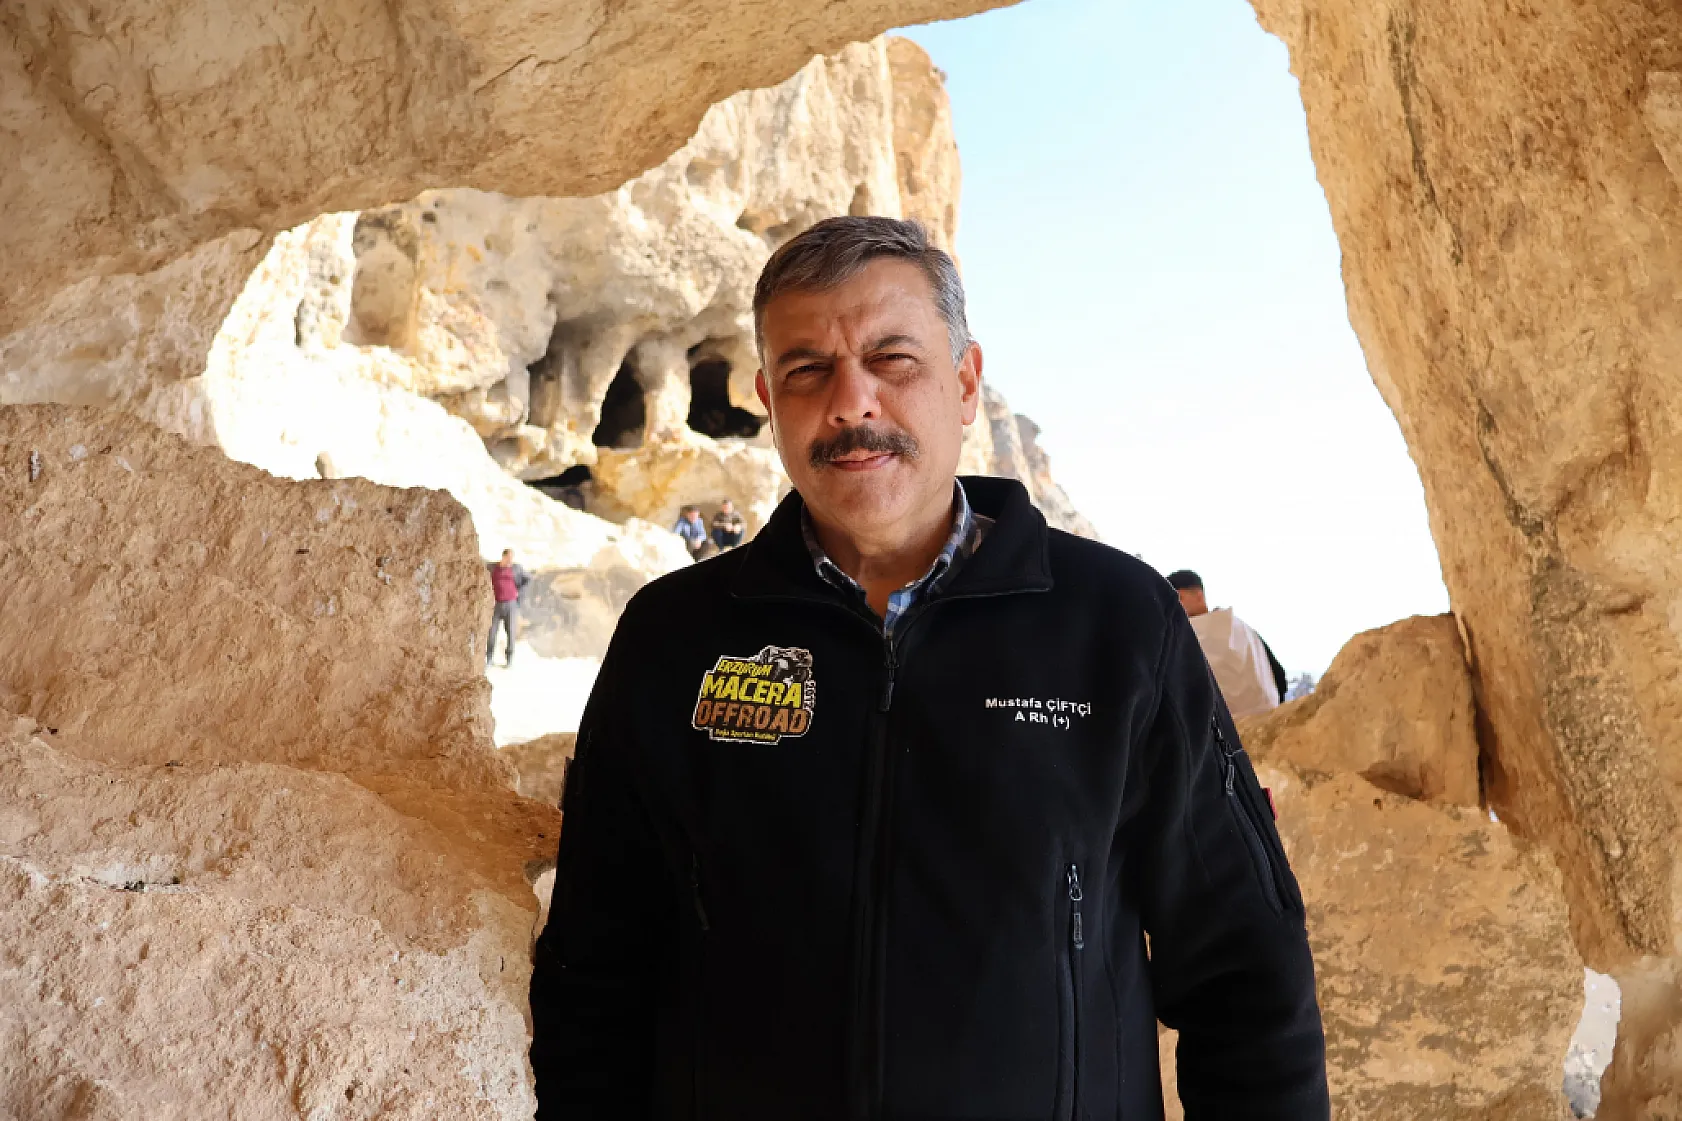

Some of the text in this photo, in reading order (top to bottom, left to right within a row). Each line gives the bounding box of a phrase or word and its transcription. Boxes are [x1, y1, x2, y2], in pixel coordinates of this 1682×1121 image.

[717, 659, 773, 677] ERZURUM
[702, 674, 802, 709] MACERA
[695, 700, 808, 733] OFFROAD
[985, 697, 1091, 718] Mustafa ÇİFTÇİ
[1015, 710, 1070, 731] A Rh (+)
